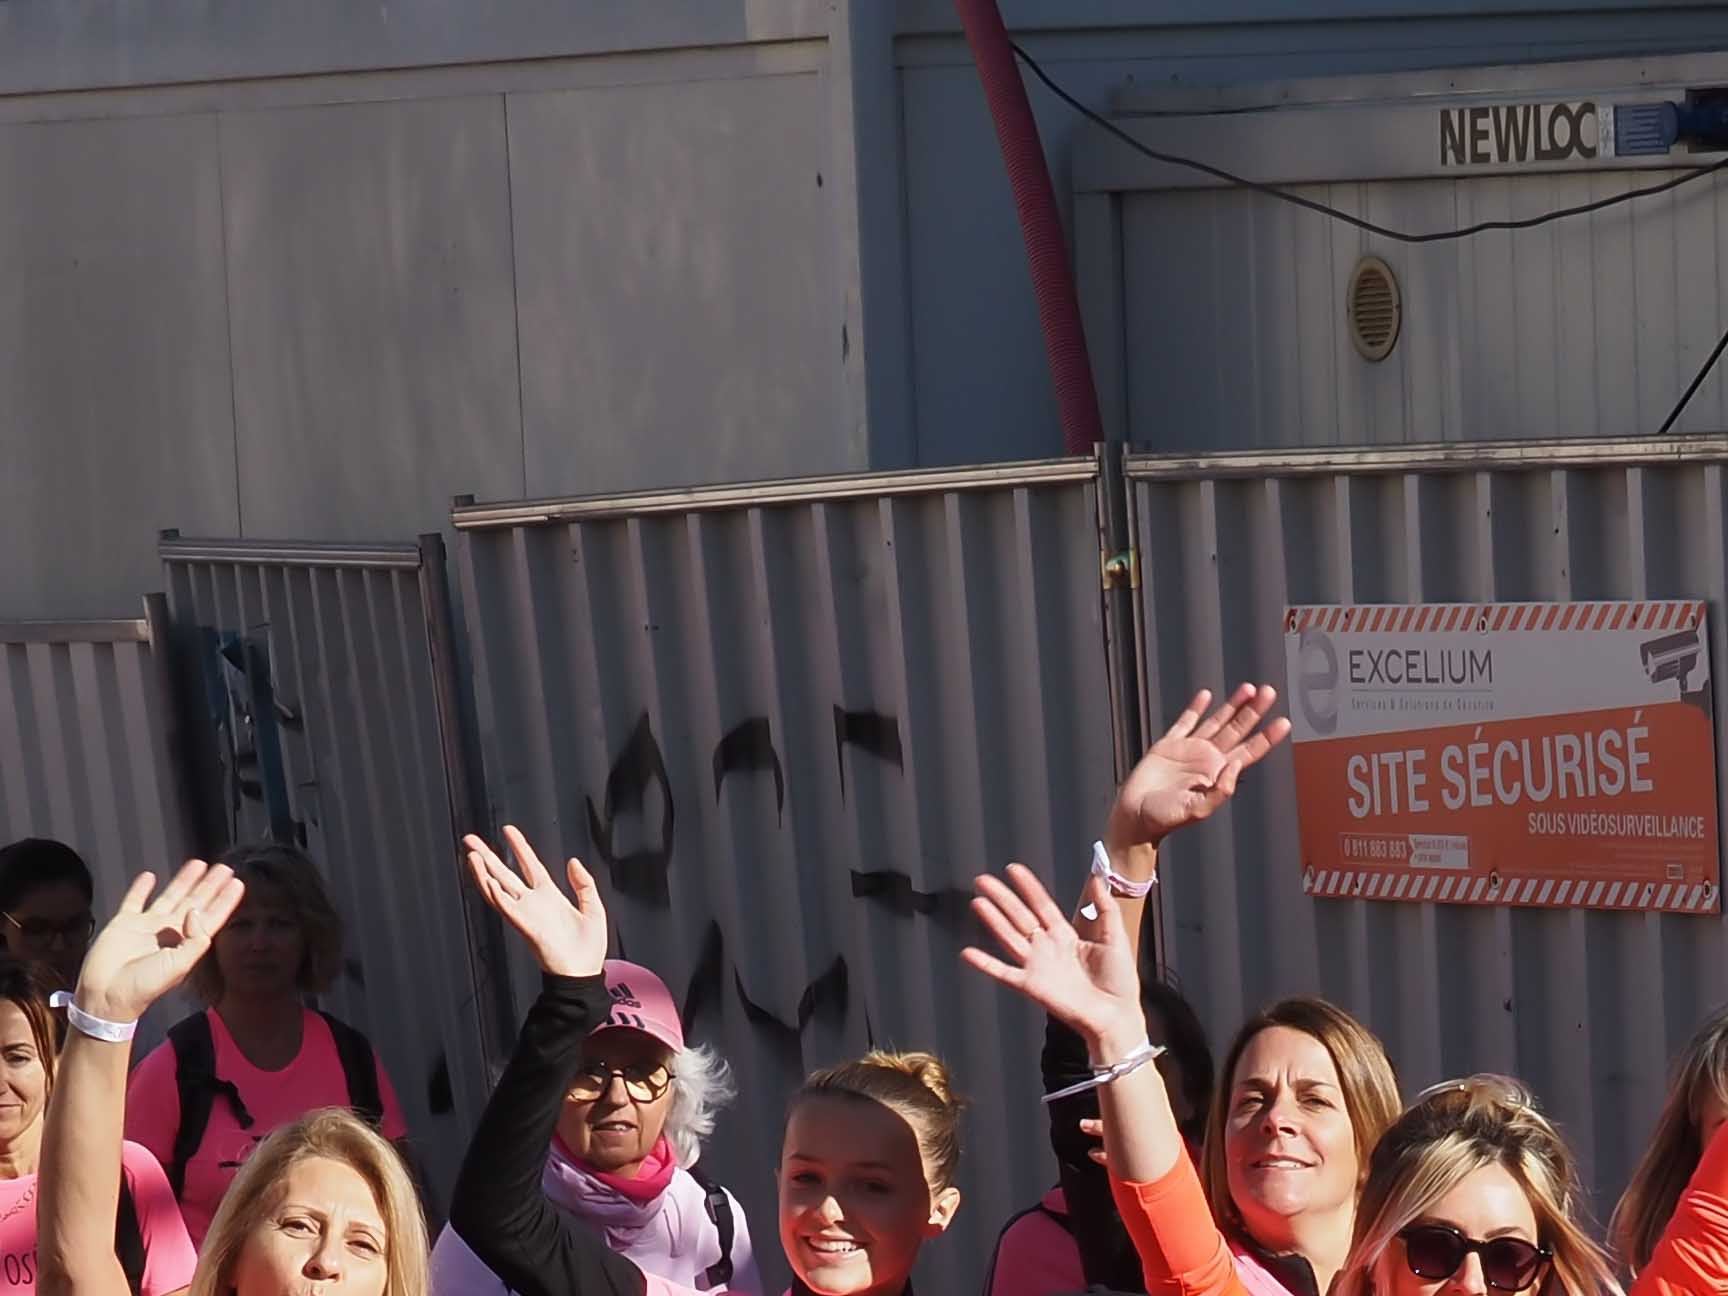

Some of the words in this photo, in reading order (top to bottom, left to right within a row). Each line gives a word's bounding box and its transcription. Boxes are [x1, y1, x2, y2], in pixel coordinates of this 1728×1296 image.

[1440, 102, 1597, 166] NEWLOC
[1348, 649, 1493, 684] EXCELIUM
[1346, 748, 1430, 818] SITE
[1441, 712, 1653, 810] SÉCURISÉ
[1528, 812, 1566, 835] SOUS
[1567, 809, 1705, 839] VIDÉOSURVEILLANCE
